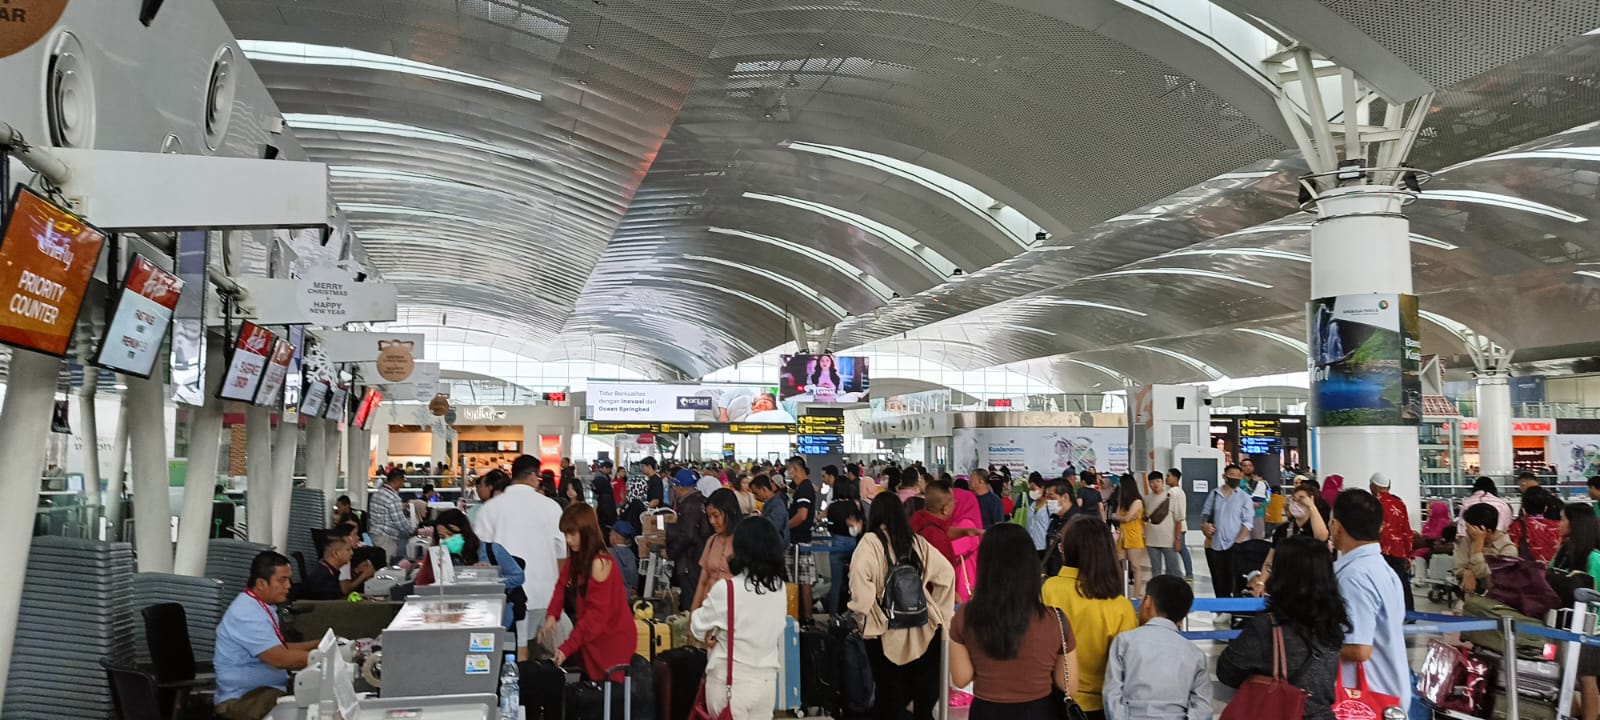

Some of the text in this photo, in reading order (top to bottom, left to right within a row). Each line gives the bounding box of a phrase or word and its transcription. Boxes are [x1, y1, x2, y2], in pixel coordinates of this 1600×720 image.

[17, 270, 67, 303] PRIORITY
[313, 282, 343, 290] MERRY
[9, 293, 60, 326] COUNTER
[313, 301, 342, 309] HAPPY
